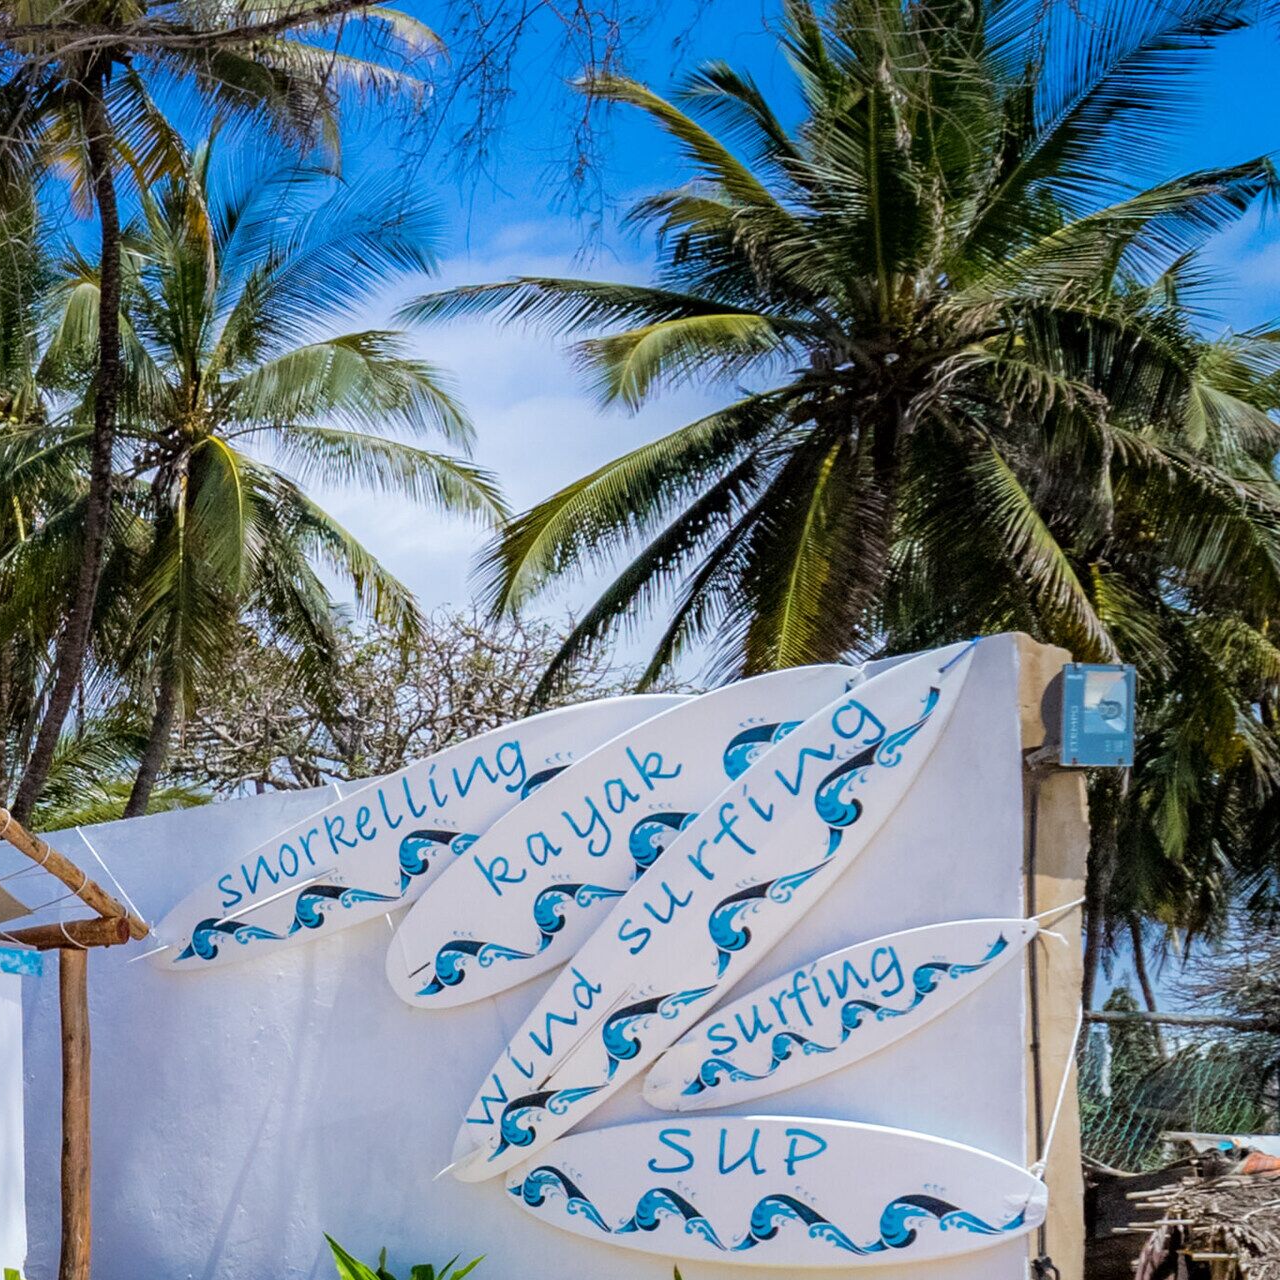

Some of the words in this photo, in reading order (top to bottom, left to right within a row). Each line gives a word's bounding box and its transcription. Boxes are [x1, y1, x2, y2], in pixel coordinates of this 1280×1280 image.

[217, 737, 527, 910] snorkelling
[474, 744, 684, 897] kayak
[467, 965, 605, 1126] wind
[616, 696, 887, 955] surfing
[707, 944, 905, 1056] surfing
[648, 1127, 829, 1177] SUP
